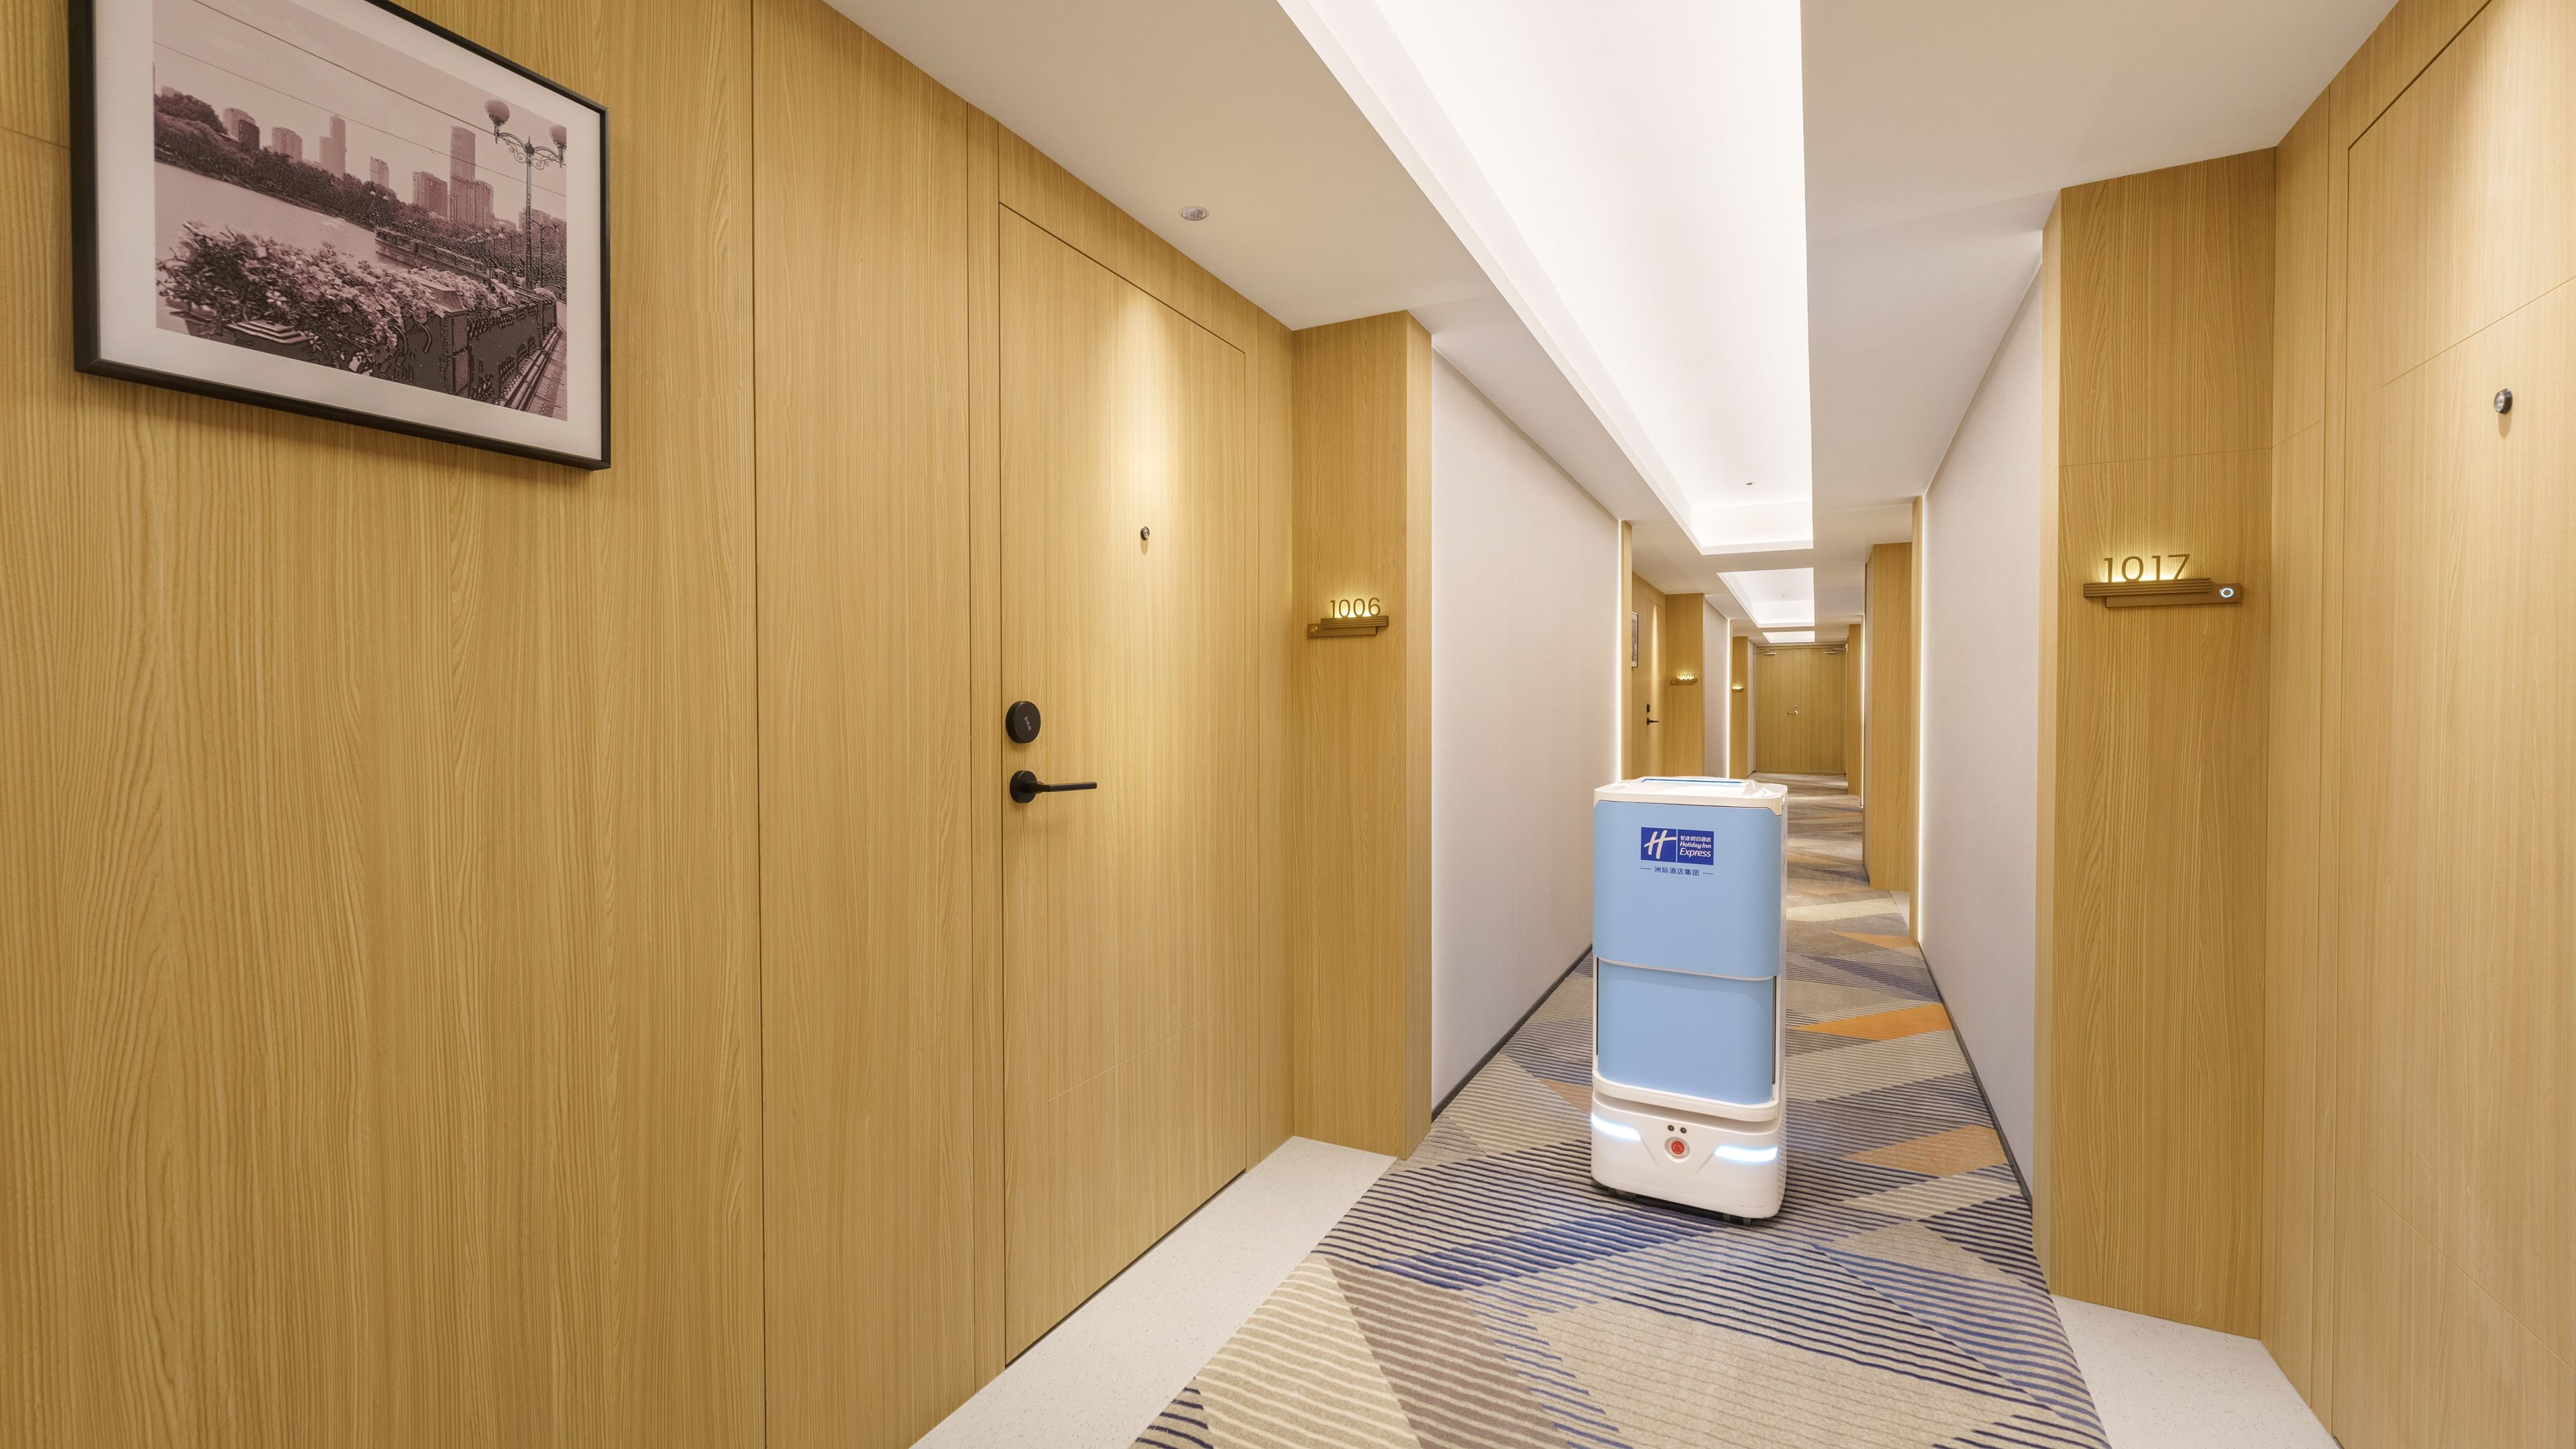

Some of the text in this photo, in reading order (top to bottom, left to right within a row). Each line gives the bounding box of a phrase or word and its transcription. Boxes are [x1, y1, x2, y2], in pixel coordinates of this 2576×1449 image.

[2104, 553, 2190, 582] 1017
[1330, 597, 1381, 618] 1006
[1679, 847, 1711, 858] Express
[1654, 866, 1699, 876] 洲际酒店集团
